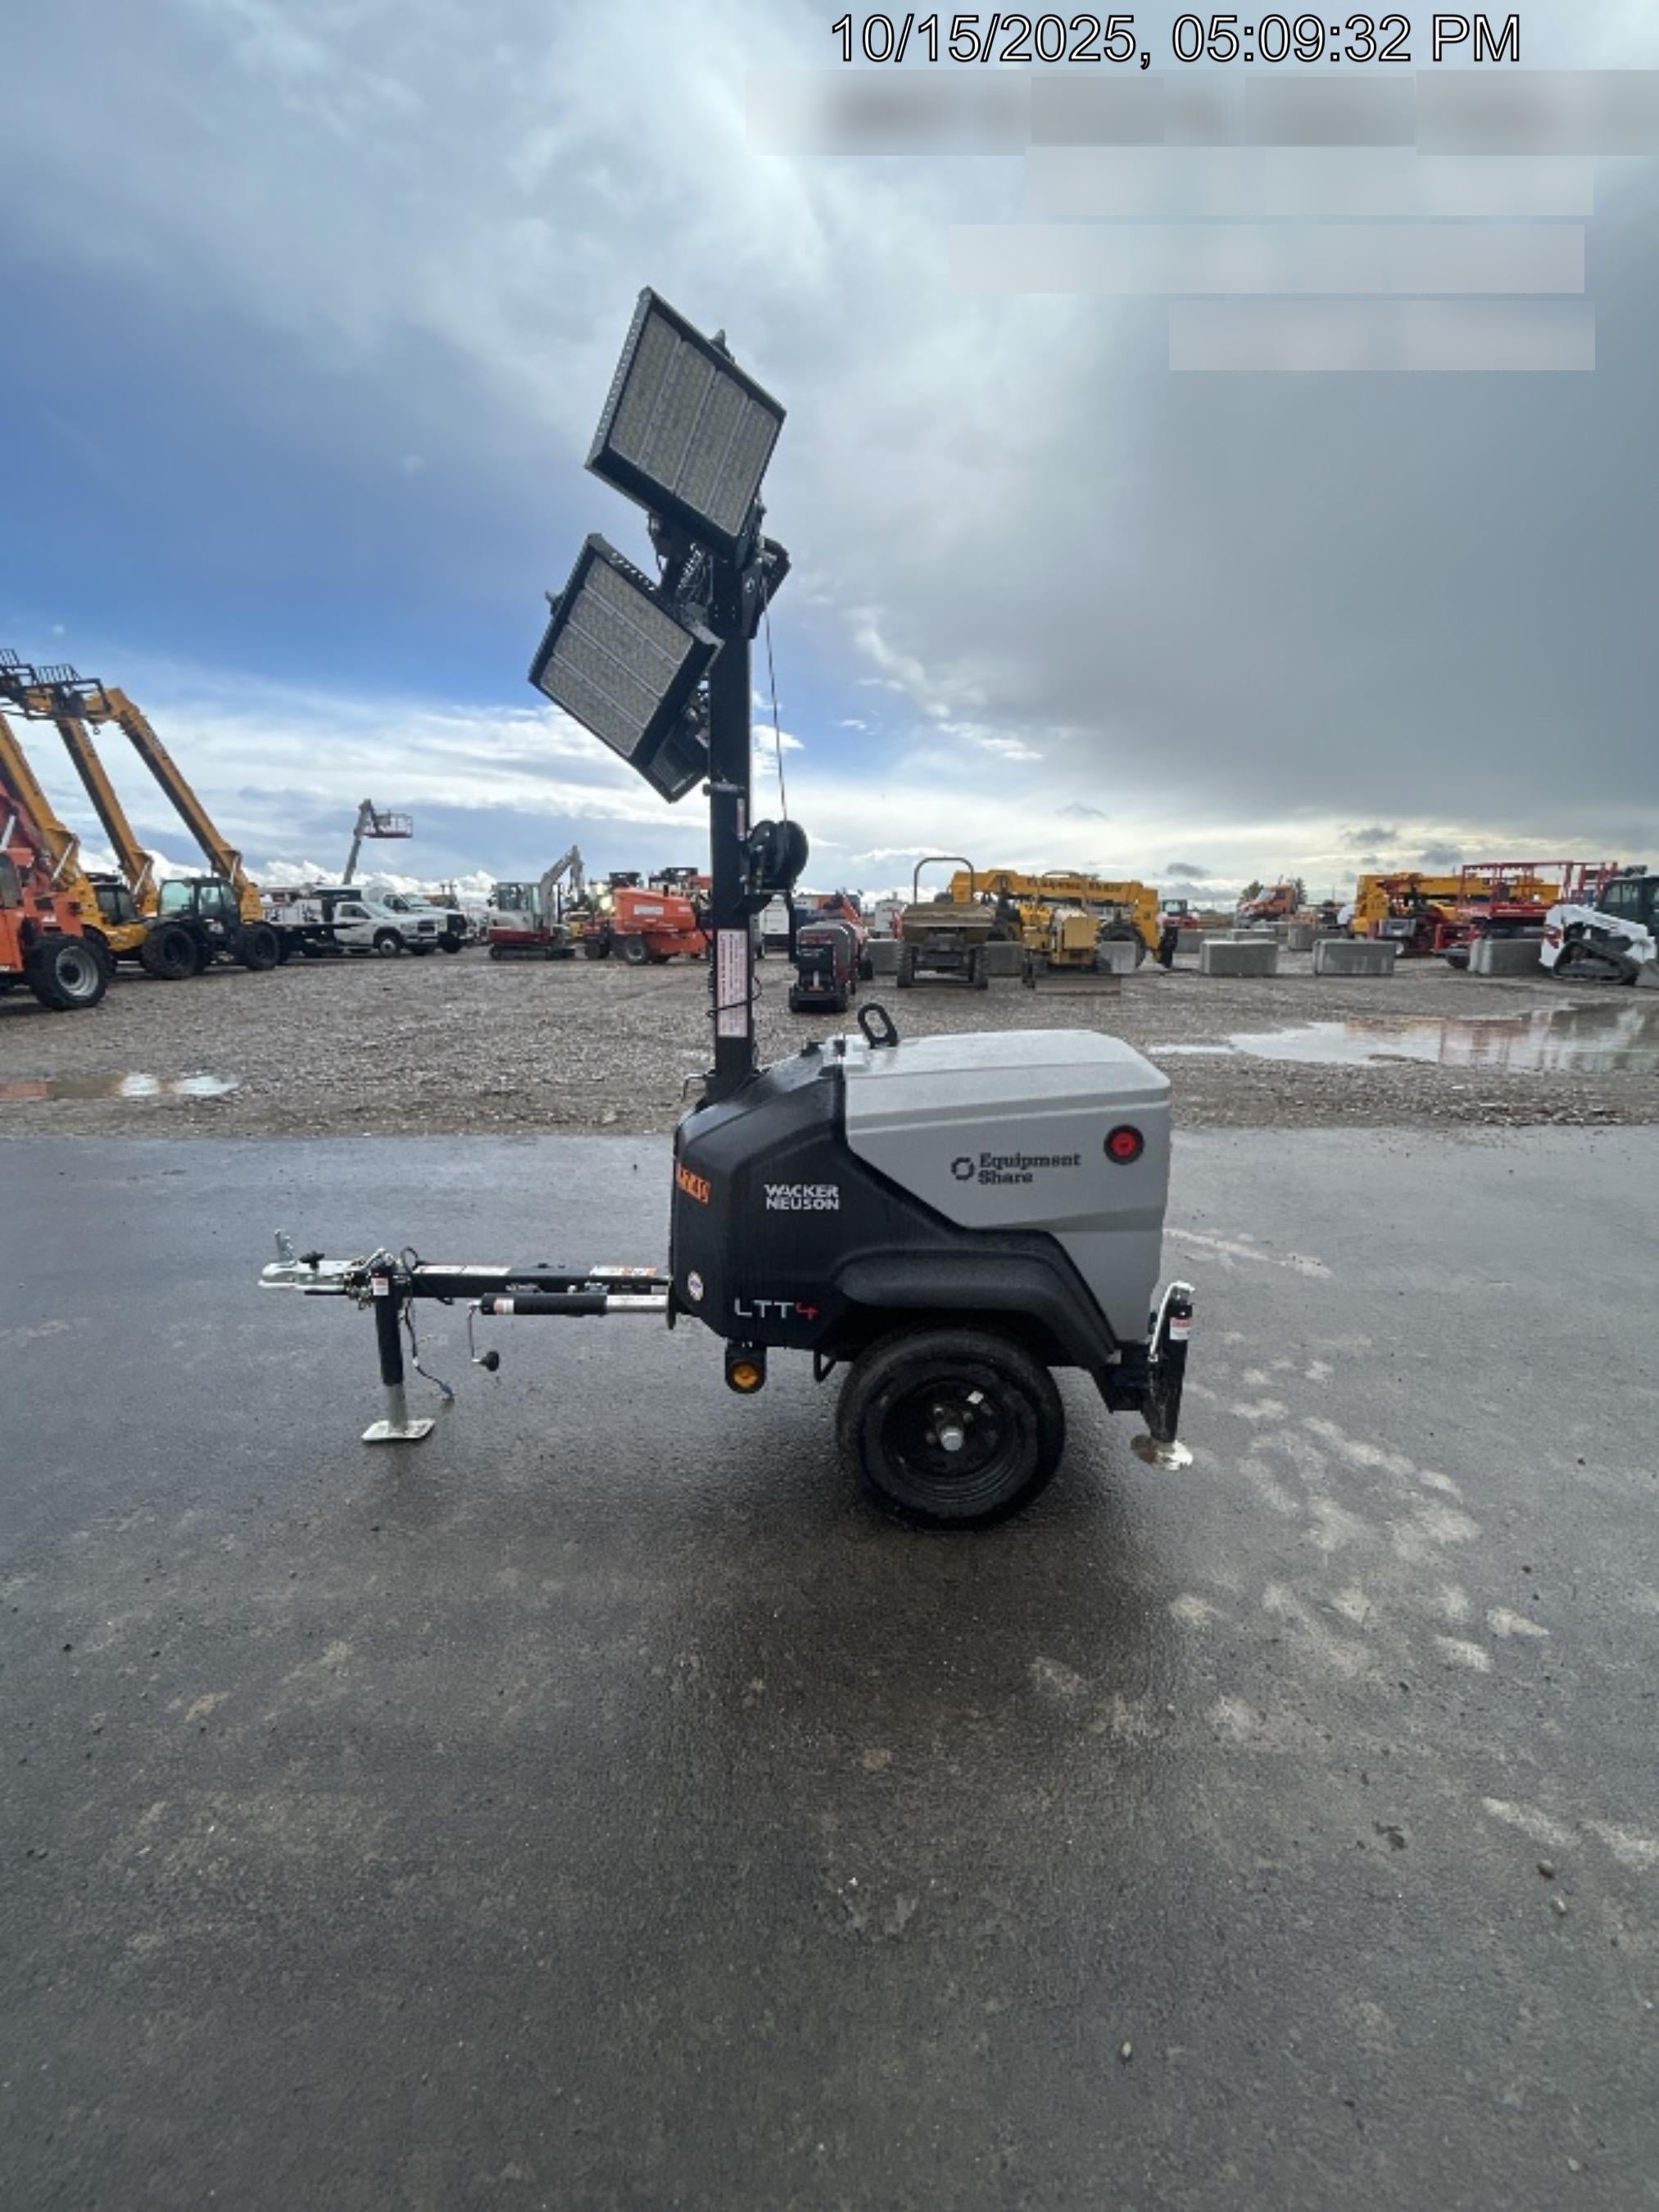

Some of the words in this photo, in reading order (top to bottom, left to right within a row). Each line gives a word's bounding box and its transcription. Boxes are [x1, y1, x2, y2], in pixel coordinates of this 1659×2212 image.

[979, 1152, 1081, 1171] Equipment
[978, 1170, 1033, 1185] Share
[764, 1184, 839, 1197] WACKER
[766, 1196, 839, 1210] NEUSON
[734, 1297, 818, 1321] LTT4
